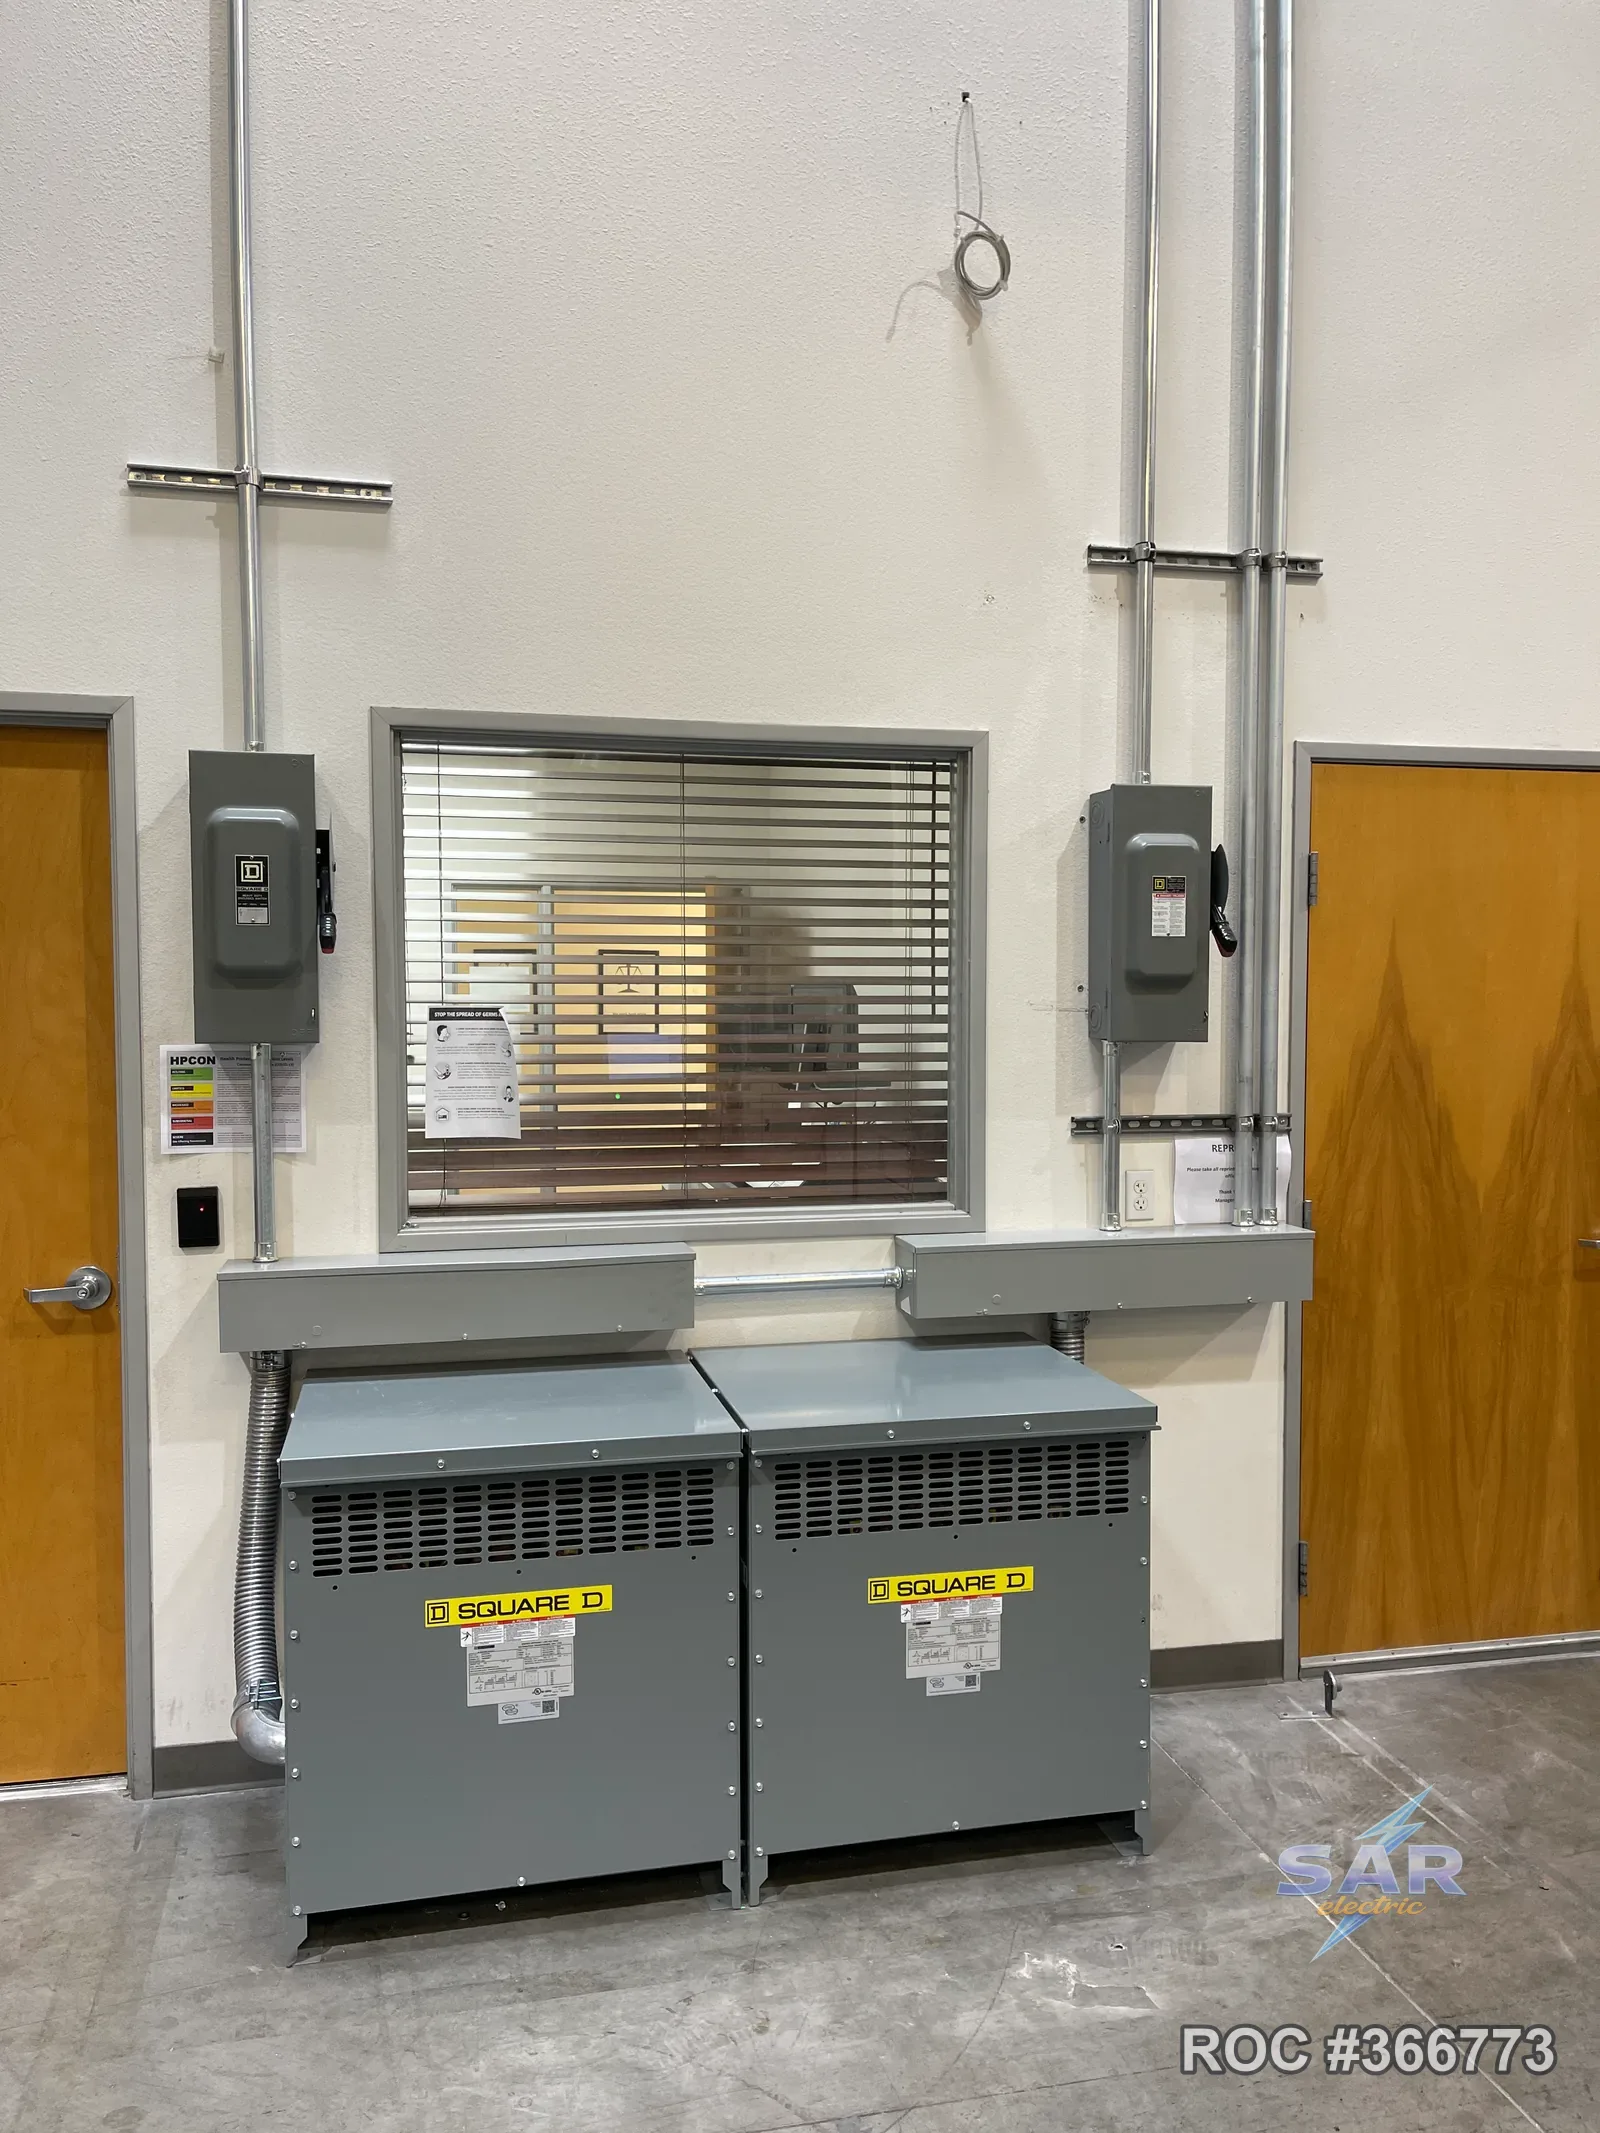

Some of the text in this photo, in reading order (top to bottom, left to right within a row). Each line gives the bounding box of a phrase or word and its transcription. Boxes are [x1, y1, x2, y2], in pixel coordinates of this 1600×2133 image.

[170, 1056, 216, 1065] HPCON
[1212, 1144, 1235, 1152] REPR
[897, 1574, 996, 1596] SQUARE
[1006, 1572, 1024, 1588] D
[458, 1594, 570, 1620] SQUARE
[582, 1592, 603, 1608] D
